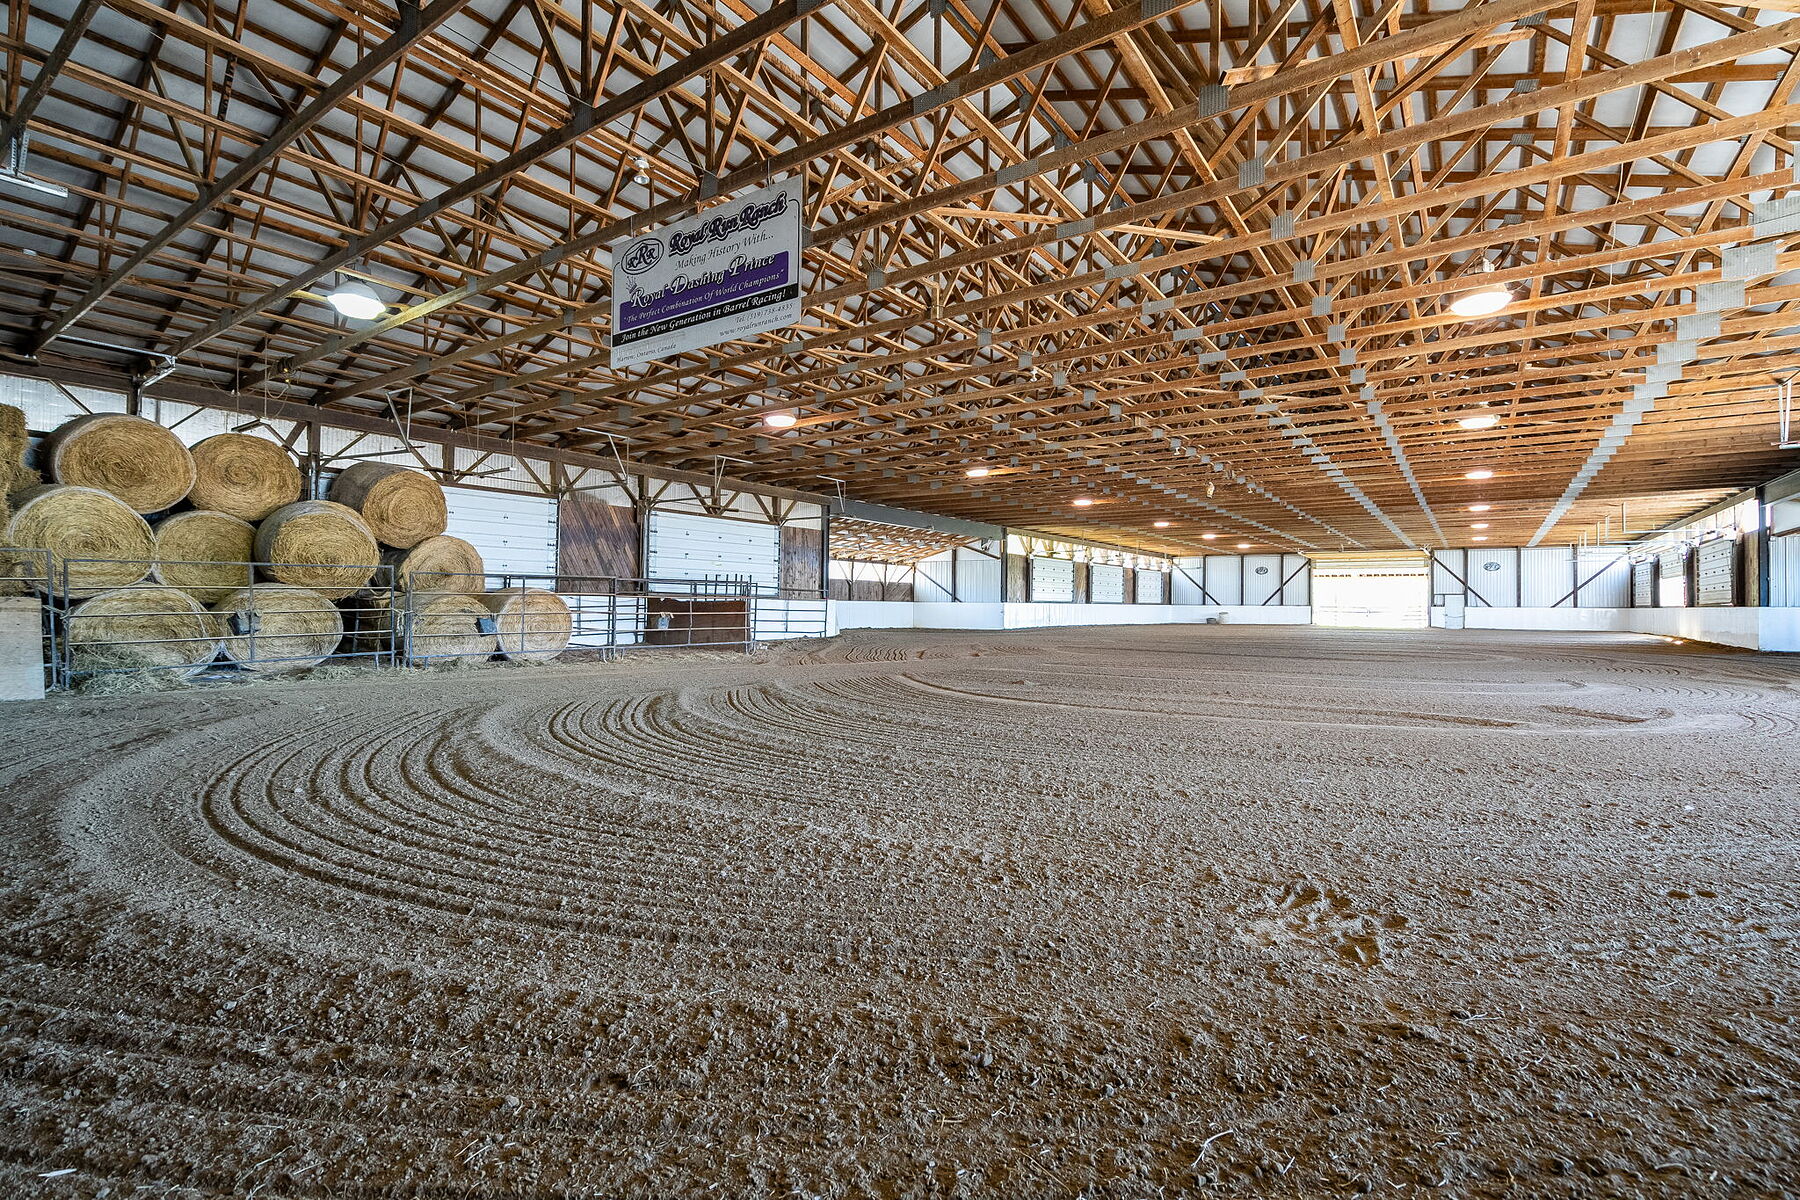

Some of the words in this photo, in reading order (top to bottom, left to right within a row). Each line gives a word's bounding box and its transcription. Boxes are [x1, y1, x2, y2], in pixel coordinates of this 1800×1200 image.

[669, 220, 708, 256] Royal
[707, 214, 740, 242] Run
[739, 191, 787, 230] Ranch
[675, 253, 706, 271] Making
[708, 241, 740, 260] History
[744, 229, 774, 246] With...
[630, 284, 667, 308] Royal
[667, 270, 725, 295] Dashing
[728, 254, 776, 277] Prince
[639, 308, 660, 320] Perfect
[661, 296, 703, 313] Combination
[704, 290, 714, 301] Of
[714, 283, 737, 297] World
[620, 331, 636, 343] Join
[637, 327, 649, 338] the
[650, 323, 668, 334] New
[669, 310, 711, 330] Generation
[713, 307, 721, 317] in
[722, 297, 751, 314] Barrel
[751, 288, 786, 307] Racing!
